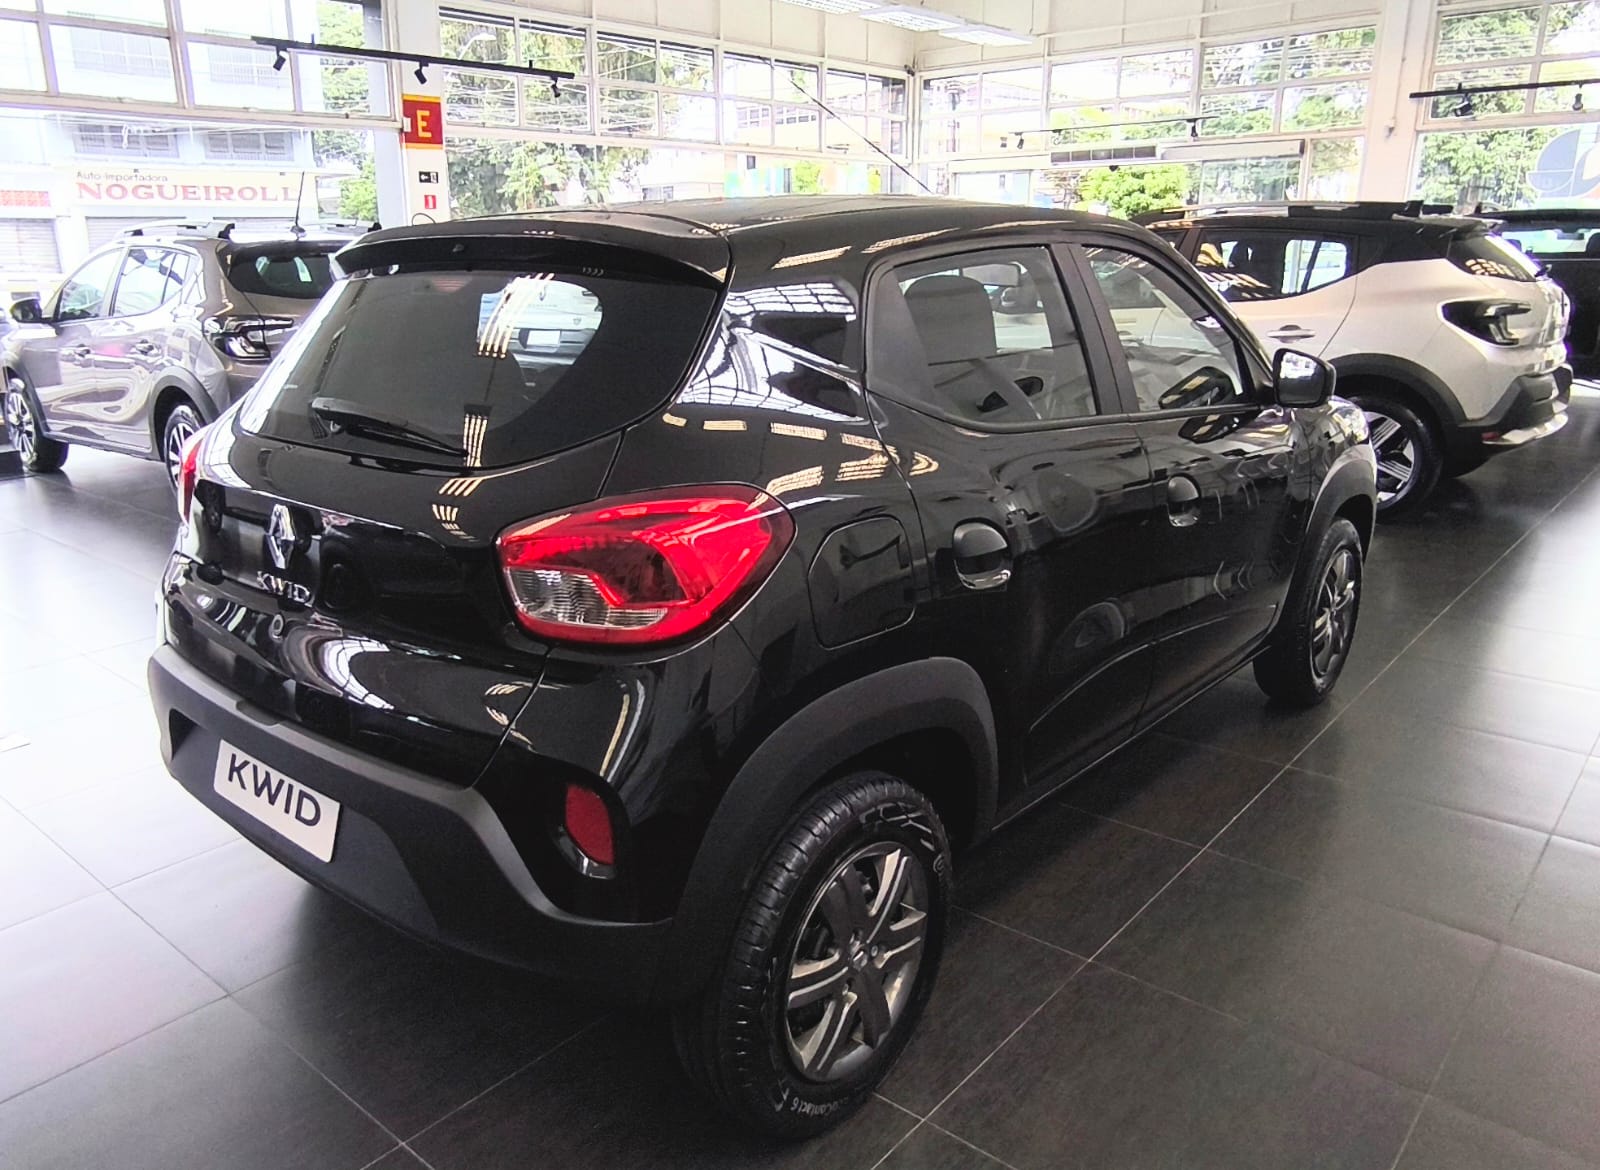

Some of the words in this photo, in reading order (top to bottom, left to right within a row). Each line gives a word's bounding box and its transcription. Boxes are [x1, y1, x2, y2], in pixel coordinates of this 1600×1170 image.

[416, 109, 432, 138] E
[256, 570, 311, 603] KWID
[228, 753, 322, 827] KWID
